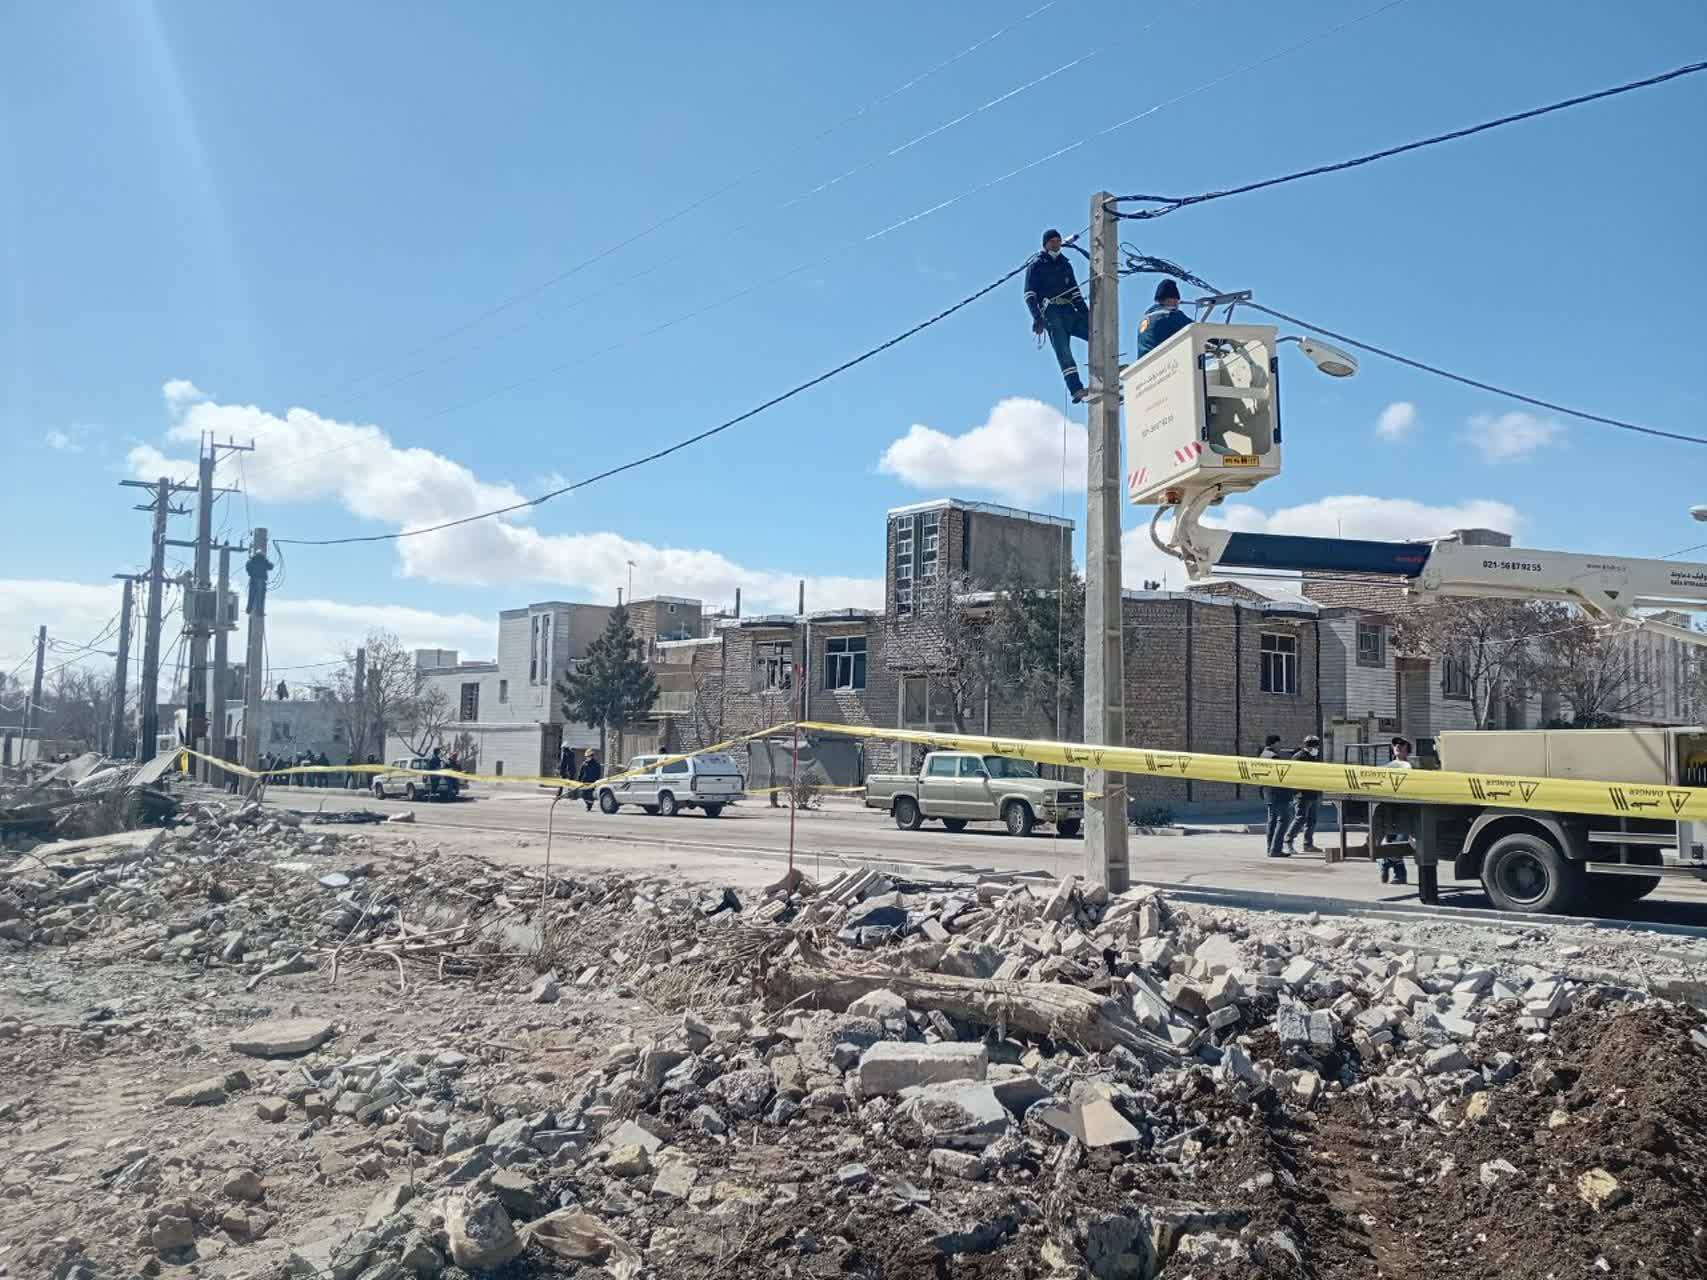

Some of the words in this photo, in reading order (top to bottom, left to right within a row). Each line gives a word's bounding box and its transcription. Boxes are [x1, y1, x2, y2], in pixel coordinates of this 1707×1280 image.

[1486, 779, 1516, 787] DANGER
[1486, 790, 1512, 799] خطر
[1629, 788, 1664, 797] DANGER
[1630, 799, 1660, 810] خطر
